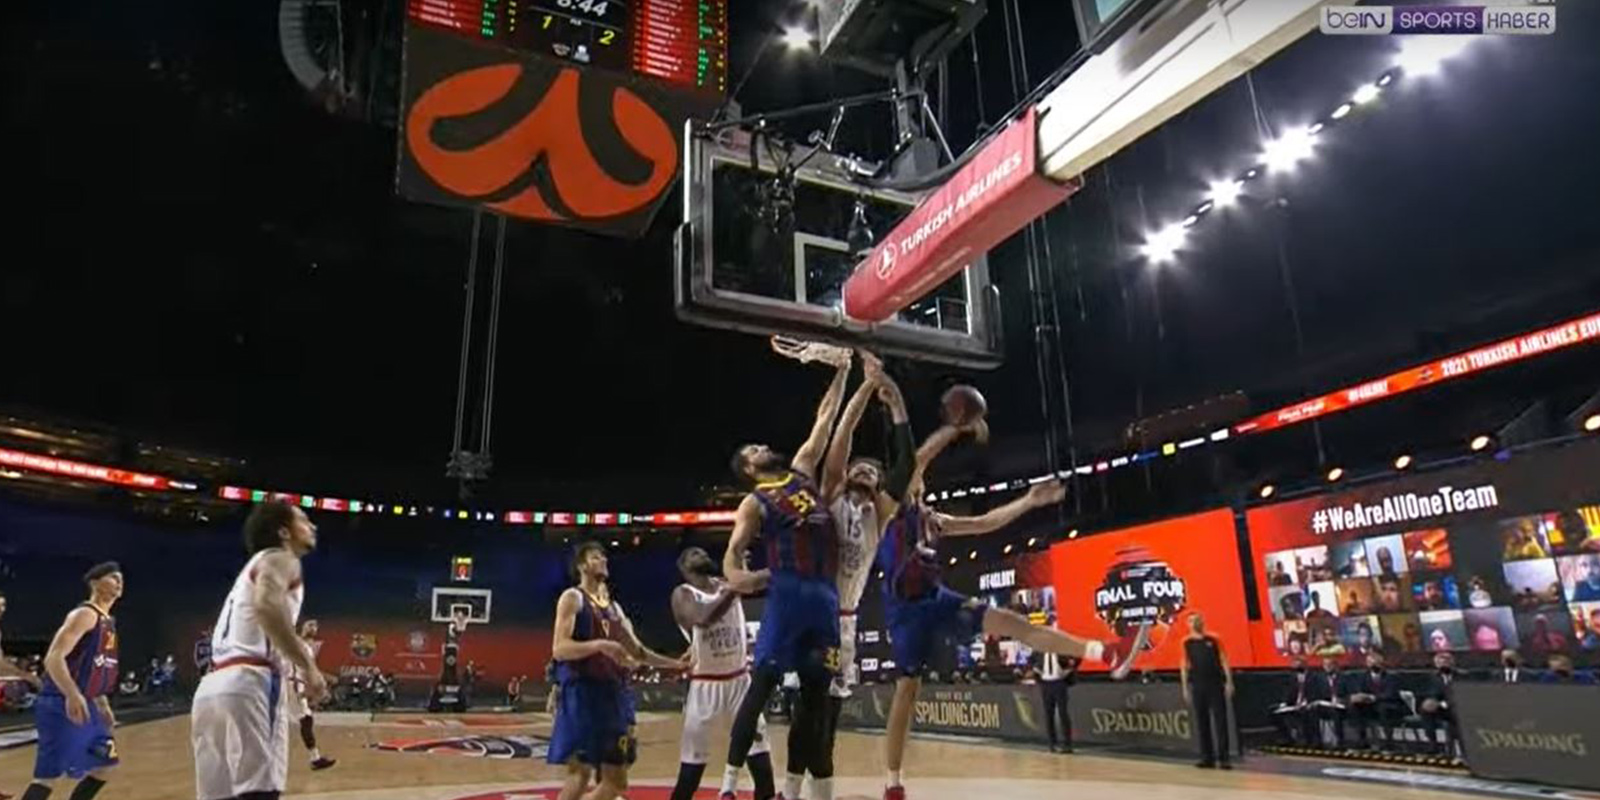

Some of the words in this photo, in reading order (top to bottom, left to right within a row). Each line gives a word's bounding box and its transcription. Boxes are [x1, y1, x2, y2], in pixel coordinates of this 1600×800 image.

[542, 15, 553, 30] 1
[600, 29, 616, 46] 2
[901, 203, 954, 255] TURKISH
[954, 150, 1022, 213] AIRLINES
[1441, 354, 1469, 377] 2021
[1470, 339, 1518, 369] TURKISH
[1519, 322, 1579, 355] AIRLINES
[789, 489, 817, 513] 33
[1312, 485, 1498, 534] #WeAreAllOneTeam
[847, 518, 862, 539] 15
[1097, 584, 1137, 607] FINAL
[1142, 581, 1185, 599] FOUR
[915, 701, 1000, 728] SPALDING.COM
[1090, 708, 1191, 740] SPALDING
[1476, 729, 1588, 755] SPALDING
